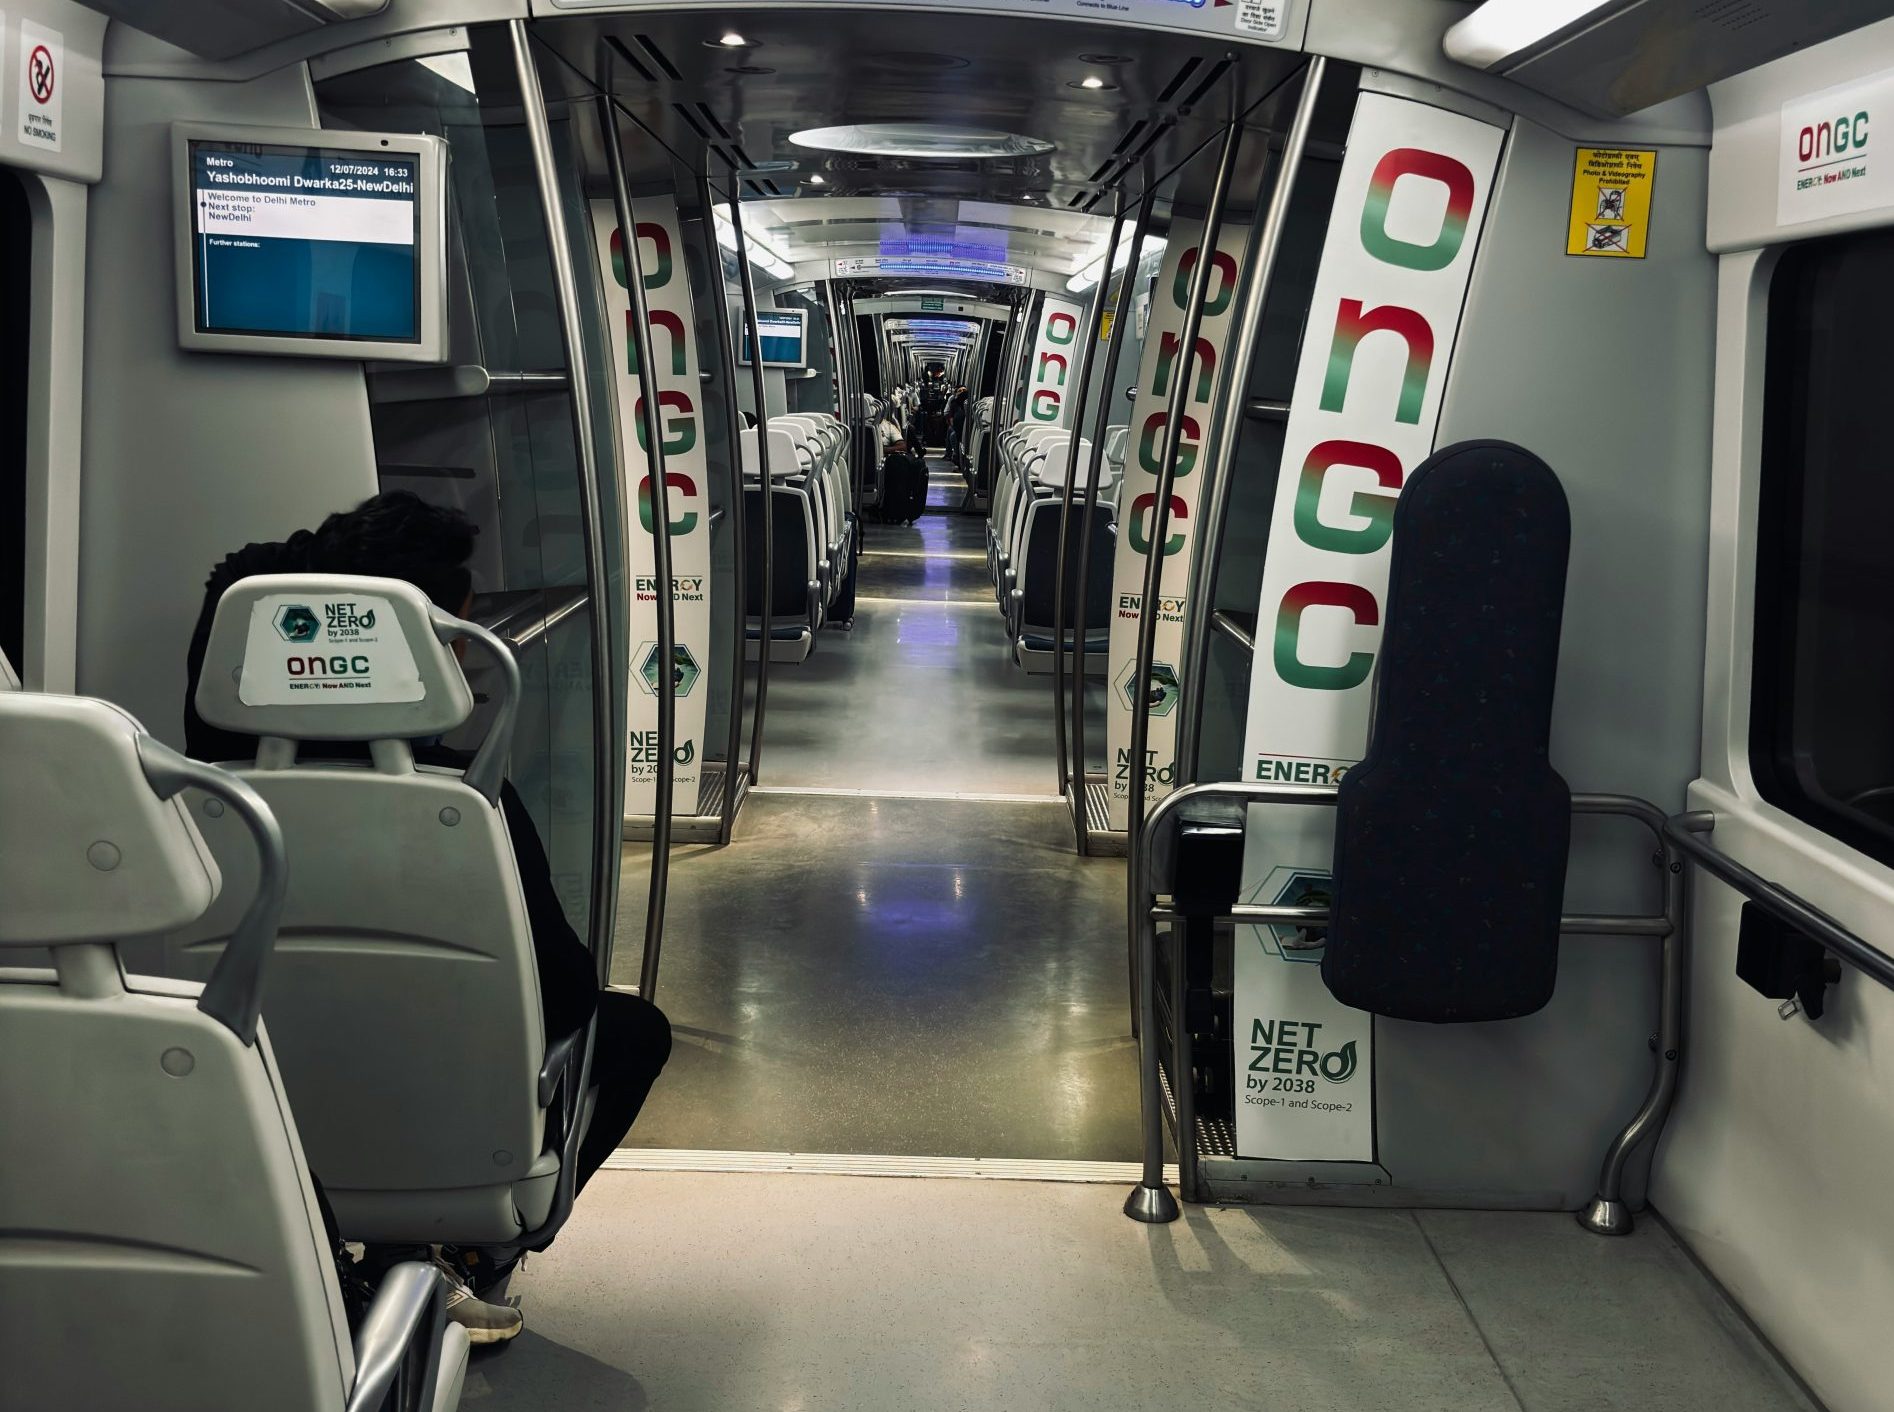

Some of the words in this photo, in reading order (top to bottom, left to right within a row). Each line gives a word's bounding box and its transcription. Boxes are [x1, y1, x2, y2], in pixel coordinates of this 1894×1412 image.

[24, 125, 32, 136] NO
[33, 127, 56, 142] SMOKING
[206, 157, 234, 167] Metro
[330, 164, 379, 176] 12/07/2024
[383, 167, 408, 177] 16:33
[1582, 169, 1601, 177] Photo
[1608, 170, 1646, 179] Videography
[1823, 171, 1838, 185] Now
[1837, 168, 1852, 181] AND
[1851, 165, 1866, 178] Next
[206, 170, 291, 187] Yashobhoomi
[293, 176, 414, 193] Dwarka25-NewDelhi
[1598, 177, 1630, 185] Prohibited
[207, 192, 250, 203] Welcome
[252, 192, 262, 203] to
[264, 195, 288, 205] Delhi
[289, 197, 316, 207] Metro
[208, 202, 229, 211] Next
[231, 203, 256, 213] stop:
[208, 211, 252, 222] NewDelhi
[209, 238, 233, 246] Further
[233, 240, 261, 248] stations:
[636, 593, 657, 601] Now
[681, 593, 703, 601] Next
[324, 603, 357, 616] NET
[1118, 609, 1140, 619] Now
[1162, 613, 1184, 623] Next
[327, 609, 376, 630] ZERO
[328, 629, 338, 638] by
[339, 629, 360, 637] 2038
[322, 682, 338, 690] Now
[1117, 747, 1158, 766] NT
[631, 764, 645, 776] by
[1114, 780, 1128, 792] by
[1251, 1018, 1323, 1048] NET
[1248, 1040, 1358, 1085] ZERO
[1246, 1074, 1269, 1094] by
[1271, 1077, 1316, 1094] 2038
[1244, 1094, 1285, 1108] Scope-1
[1288, 1098, 1308, 1110] and
[1310, 1099, 1353, 1113] Scope-2
